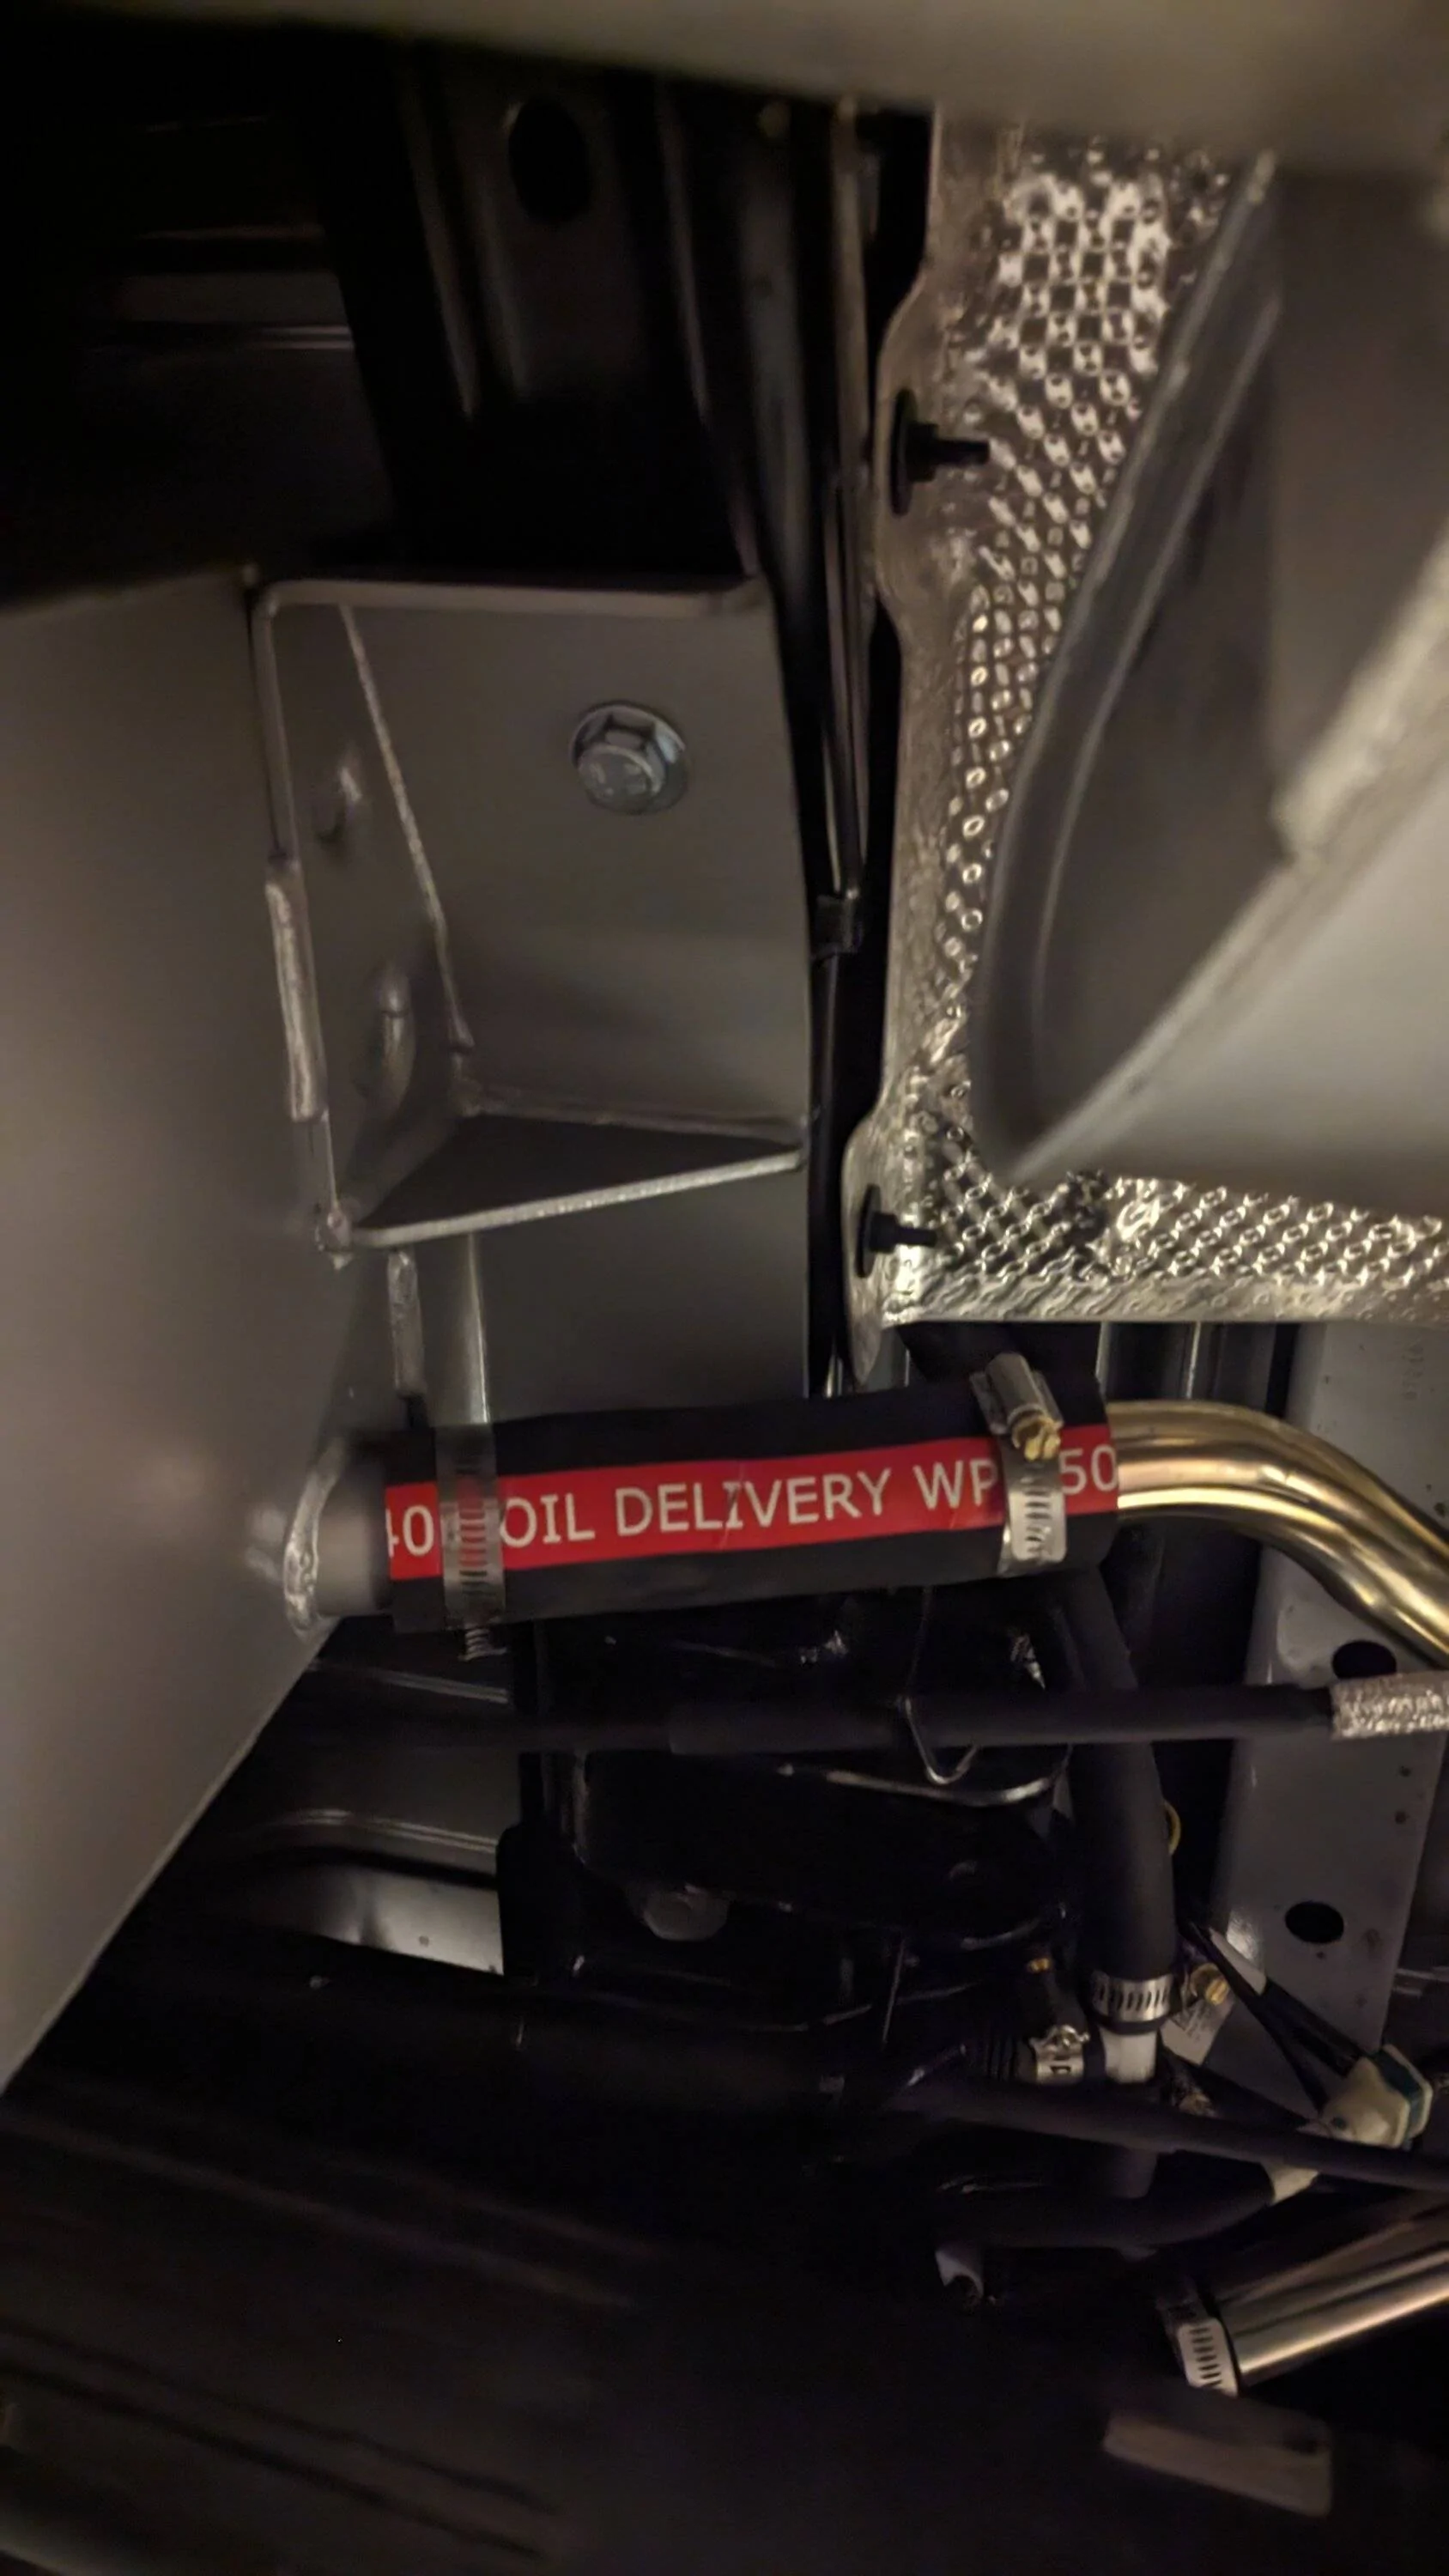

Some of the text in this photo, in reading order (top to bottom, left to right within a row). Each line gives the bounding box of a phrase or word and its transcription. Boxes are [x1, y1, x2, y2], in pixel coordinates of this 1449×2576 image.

[500, 1493, 595, 1547] OIL
[615, 1467, 891, 1536] DELIVERY
[913, 1458, 998, 1510] WP
